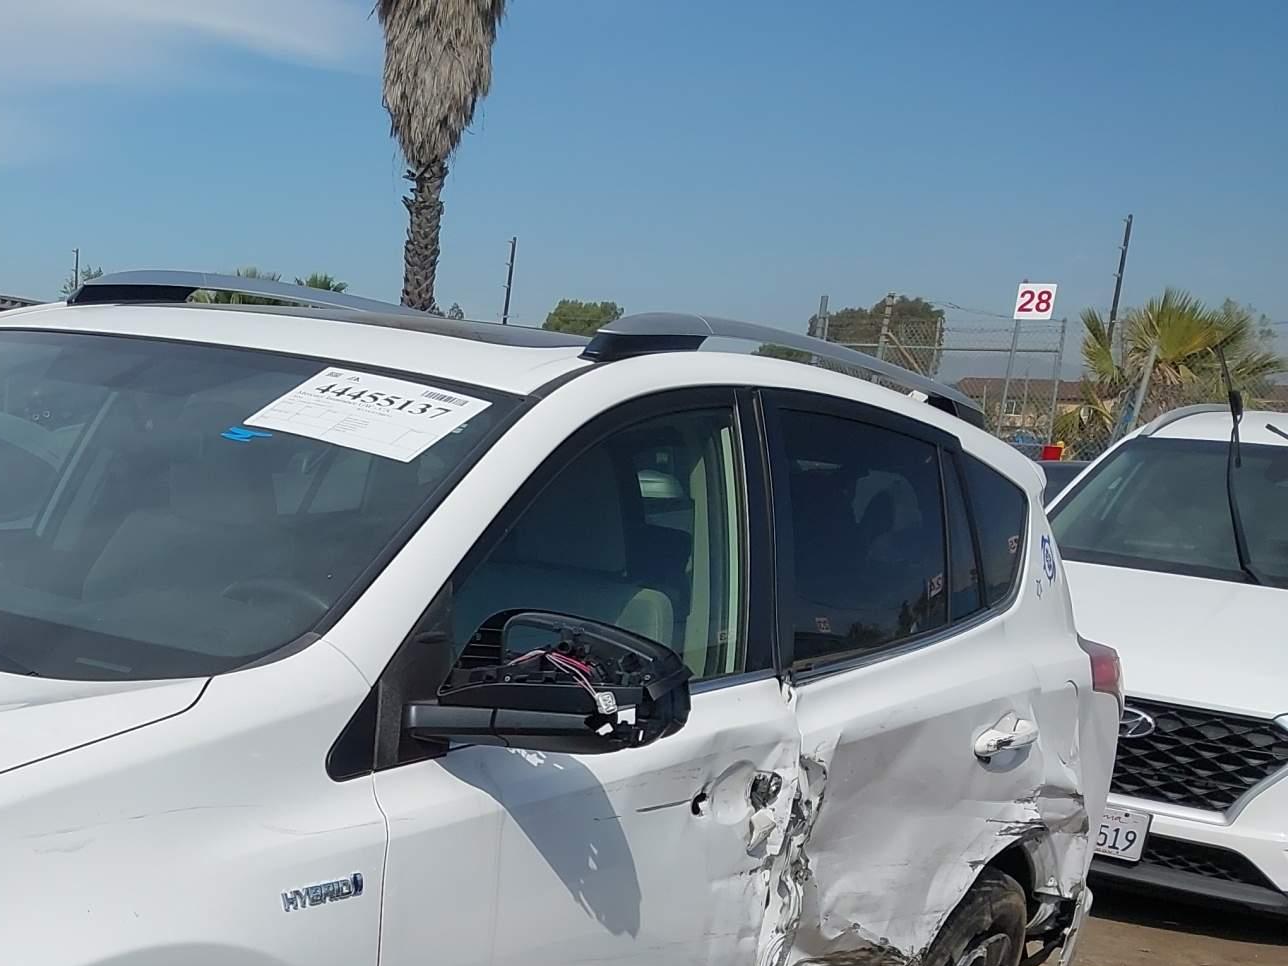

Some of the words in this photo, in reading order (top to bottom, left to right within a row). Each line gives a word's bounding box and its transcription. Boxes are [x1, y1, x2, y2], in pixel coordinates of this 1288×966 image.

[1017, 290, 1053, 313] 28
[315, 383, 452, 420] 44455137
[281, 879, 353, 912] HYBRID
